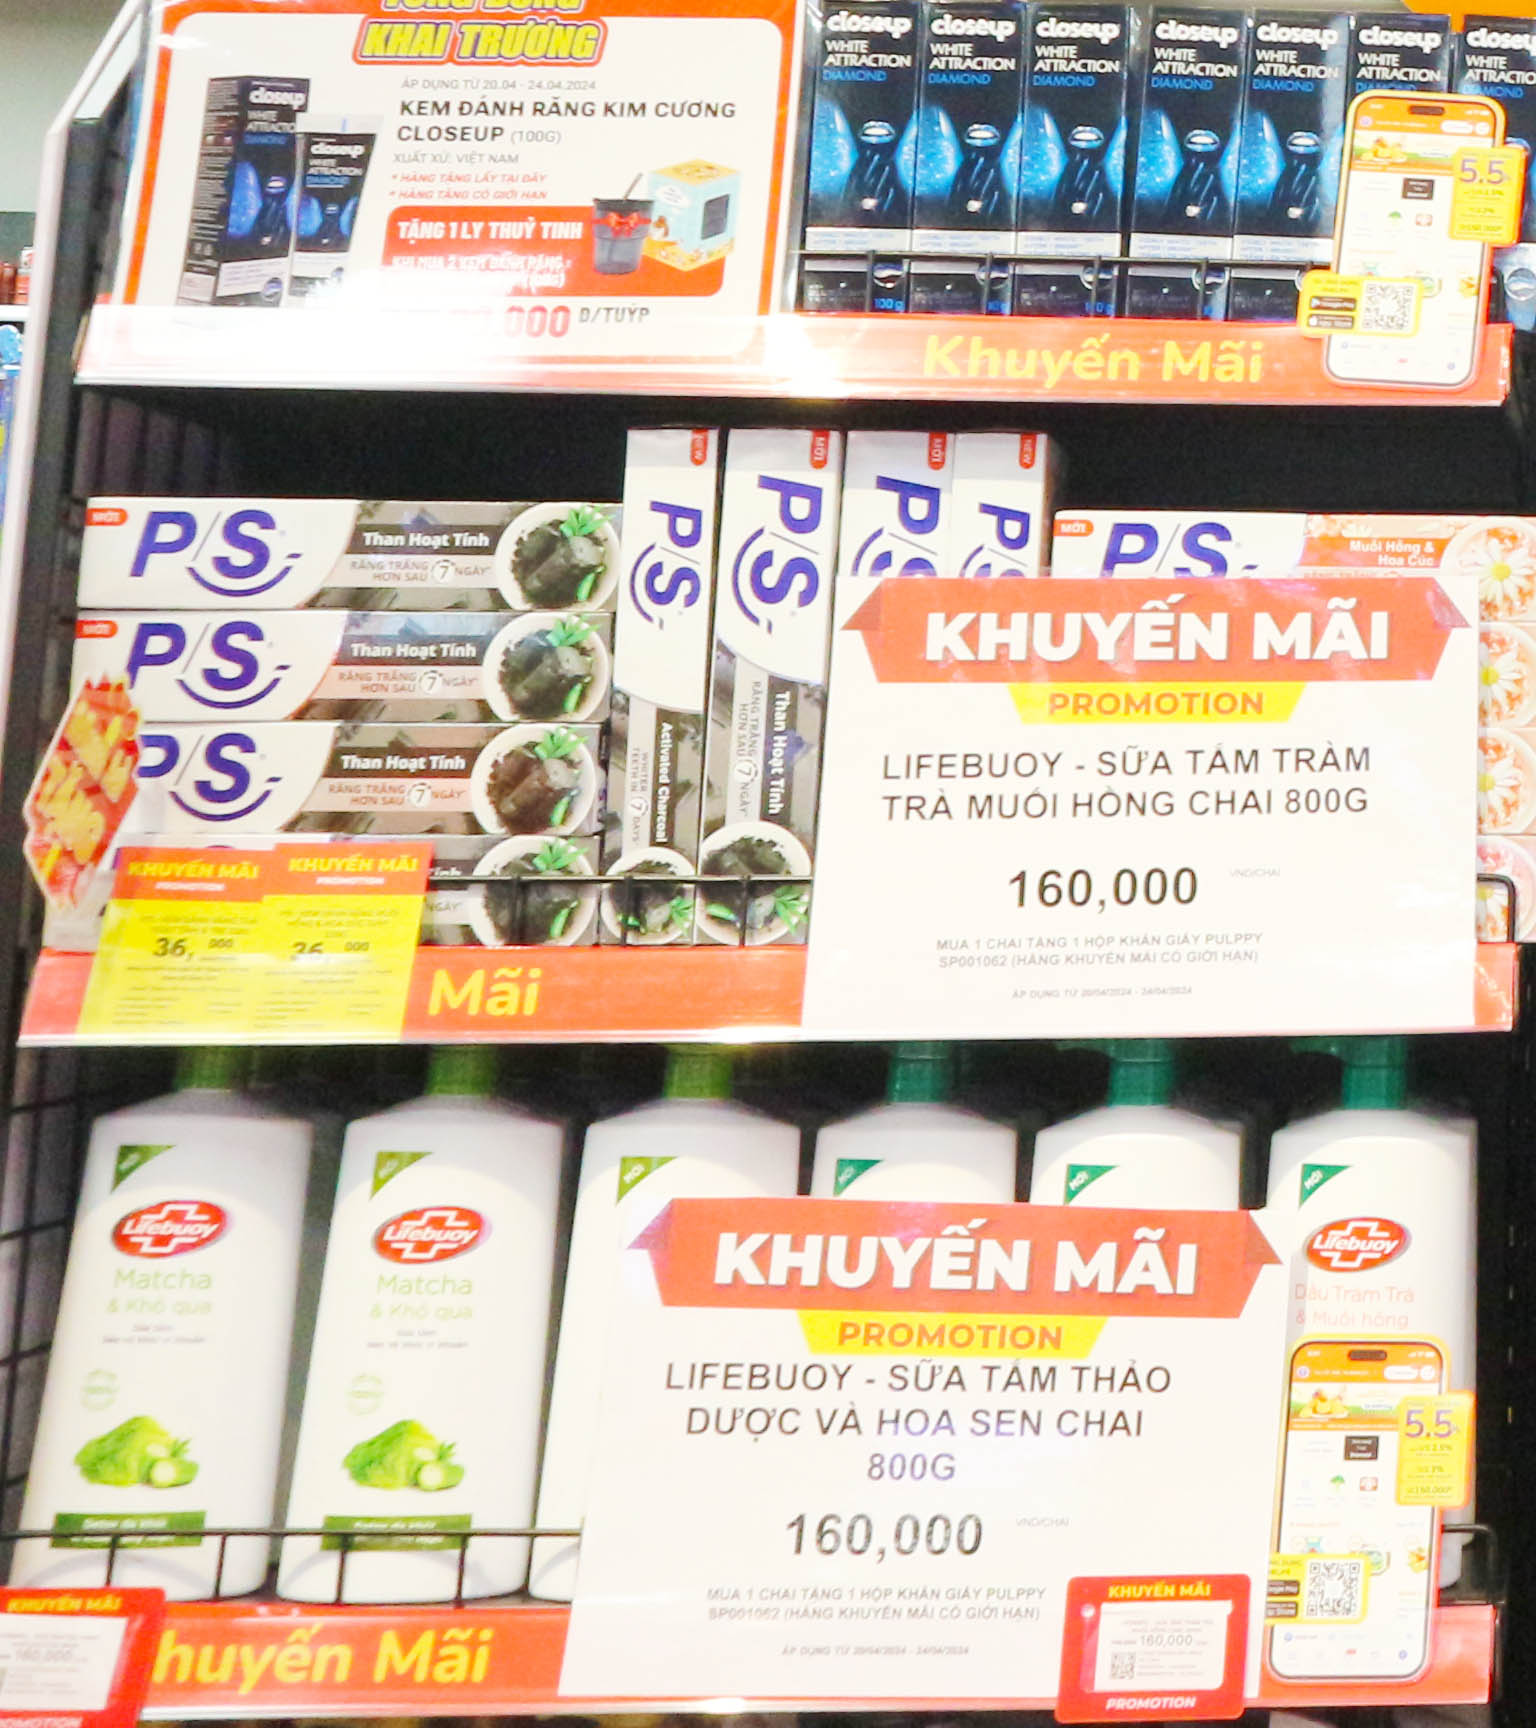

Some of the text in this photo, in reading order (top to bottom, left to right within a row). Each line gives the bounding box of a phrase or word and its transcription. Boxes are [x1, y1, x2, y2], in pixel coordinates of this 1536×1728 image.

[359, 17, 601, 62] KHAI TRƯƠNG
[826, 10, 913, 40] closeup
[930, 13, 1016, 42] closeup
[1035, 17, 1121, 45] closeup
[1154, 20, 1238, 48] closeup
[1256, 22, 1339, 51] closeup
[1358, 24, 1441, 54] closeup
[823, 53, 912, 69] ATTRACTION
[825, 40, 868, 53] WHITE
[823, 69, 887, 82] DIAMOND
[400, 94, 736, 118] KEM ĐÁNH RĂNG KIM CƯƠNG
[397, 125, 561, 144] CLOSEUP (100G)
[397, 218, 446, 245] TẶNG
[449, 222, 457, 240] 1
[461, 222, 483, 240] LY
[540, 222, 583, 240] TINH
[922, 332, 1262, 387] Khuyến Mãi
[130, 510, 281, 579] P/S
[363, 531, 489, 551] Than Hoạt Tính
[925, 594, 1389, 662] KHUYẾN MÃI
[350, 642, 477, 661] Than Hoạt Tính
[1048, 691, 1264, 717] PROMOTION
[882, 751, 1063, 780] LIFEBUOY
[1097, 745, 1173, 777] SỮA
[1272, 742, 1371, 773] TRÀM
[881, 789, 953, 821] TRÀ
[1188, 790, 1273, 816] CHAI
[1284, 788, 1368, 814] 800G
[1008, 866, 1198, 914] 160,000
[428, 967, 542, 1016] Mãi
[123, 1220, 218, 1236] Lifebuoy
[382, 1226, 478, 1243] Lifebuoy
[712, 1218, 1200, 1296] KHUYẾN MÃI
[1313, 1233, 1399, 1253] Lifebuoy
[113, 1269, 213, 1289] Matcha
[377, 1274, 473, 1295] Matcha
[838, 1321, 1064, 1352] PROMOTION
[665, 1362, 853, 1391] LIFEBUOY
[887, 1358, 967, 1392] SỮA
[1071, 1360, 1171, 1394] THẢO
[686, 1402, 1144, 1442] DƯỢC VÀ HOA SEN CHAI
[867, 1453, 957, 1482] 800G
[785, 1513, 983, 1563] 160,000
[1109, 1581, 1210, 1599] KHUYẾN MÃI
[152, 1624, 494, 1696] huyến Mãi
[1106, 1696, 1196, 1711] PROMOTION
